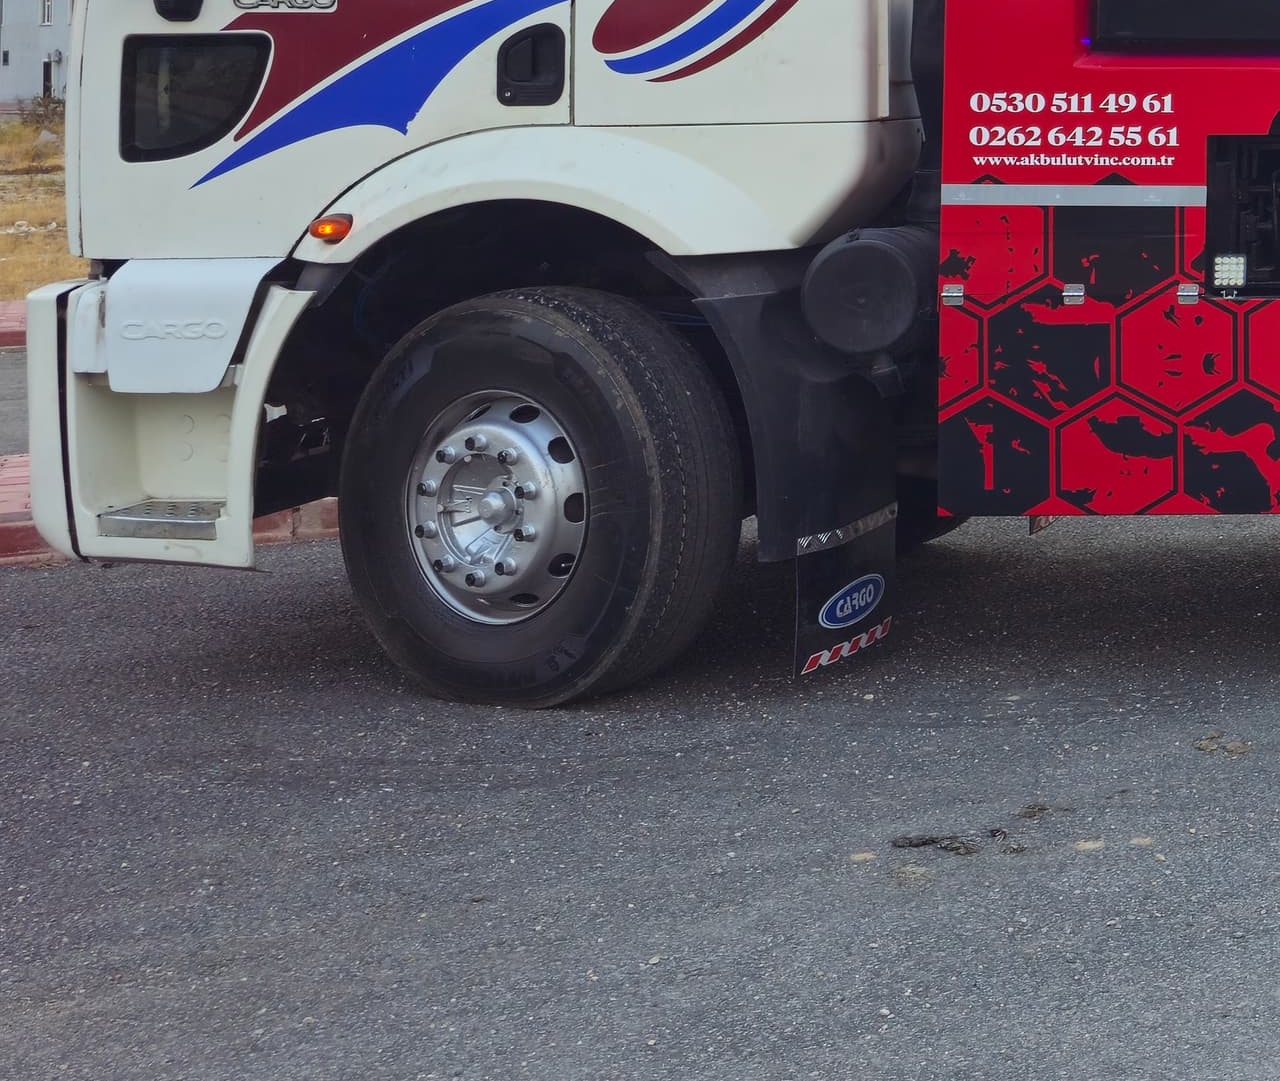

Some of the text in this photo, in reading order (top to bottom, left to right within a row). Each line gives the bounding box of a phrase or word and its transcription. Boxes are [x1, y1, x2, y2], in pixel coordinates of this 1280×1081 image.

[969, 92, 1174, 113] 0530 511 49 61
[969, 126, 1180, 147] 0262 642 55 61
[972, 153, 1175, 166] www.akbulutvinc.com.tr
[835, 583, 875, 618] CARGO
